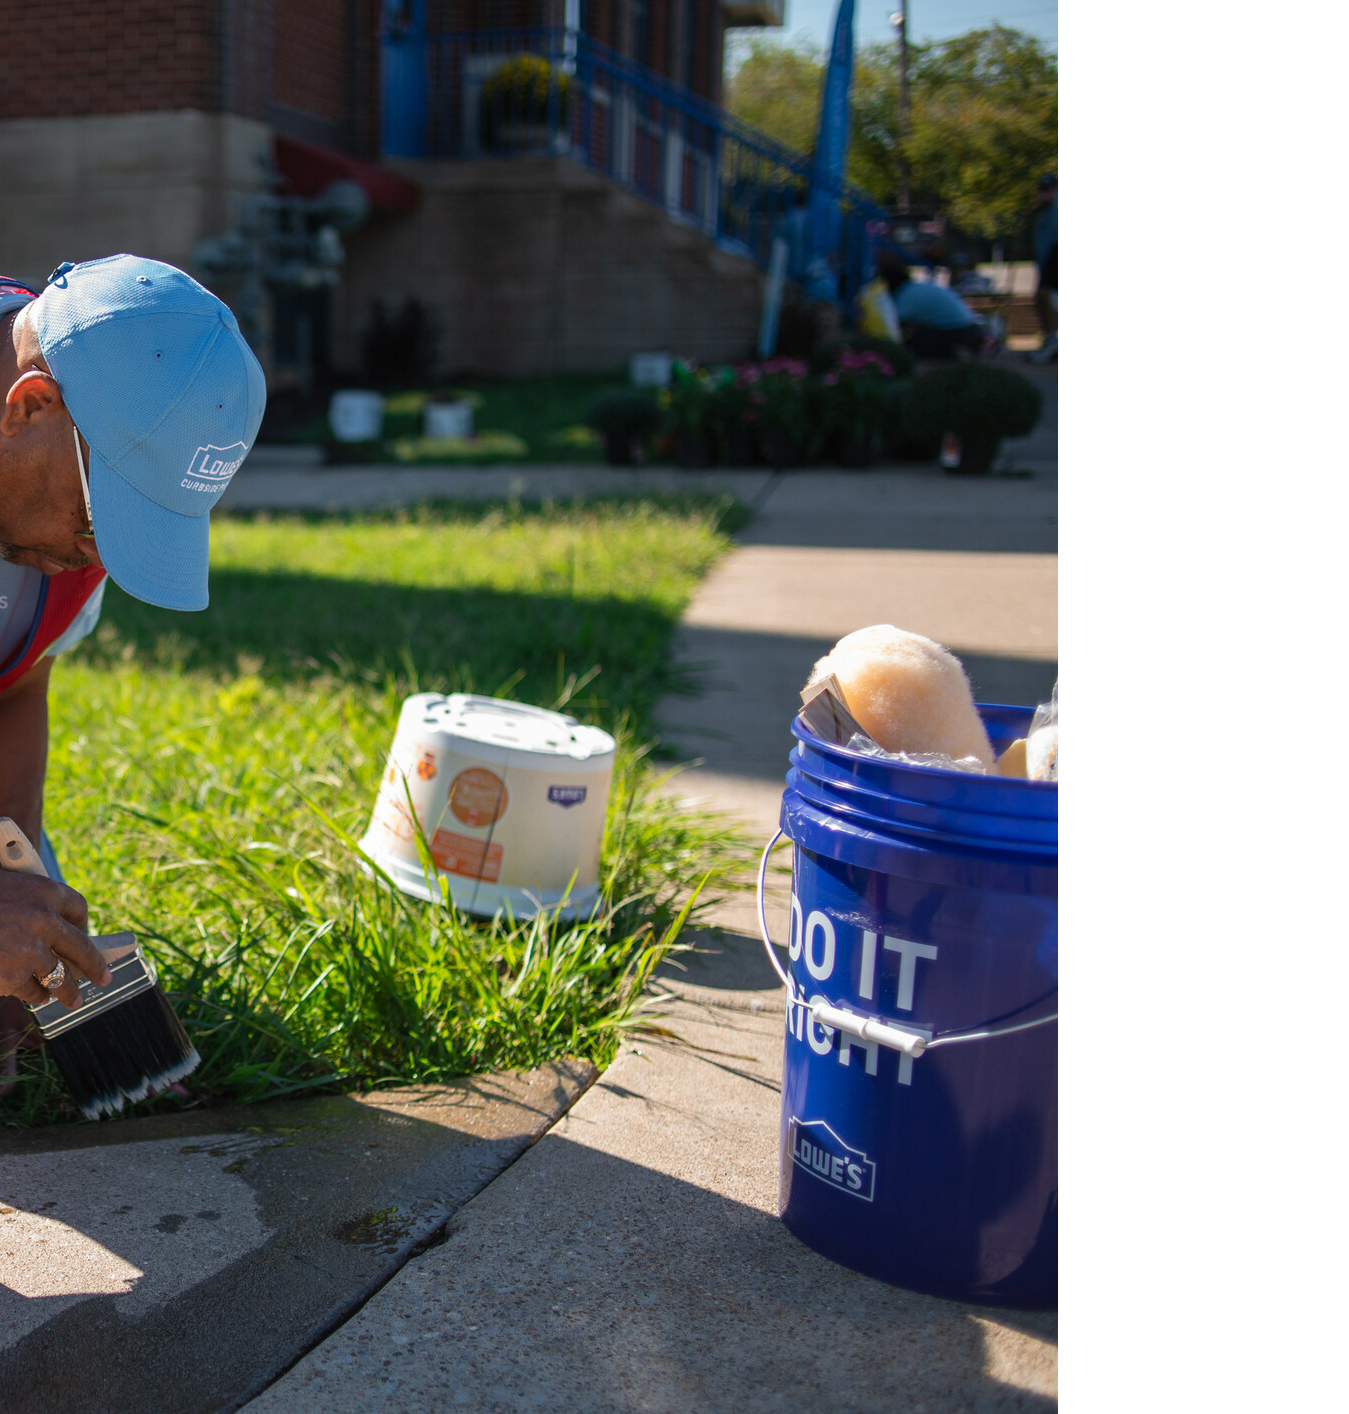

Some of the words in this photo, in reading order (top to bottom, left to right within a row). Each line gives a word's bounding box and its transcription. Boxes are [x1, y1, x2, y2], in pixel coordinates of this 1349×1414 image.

[789, 892, 836, 981] DO
[859, 930, 938, 1011] IT
[793, 1126, 863, 1190] LOWE'S
